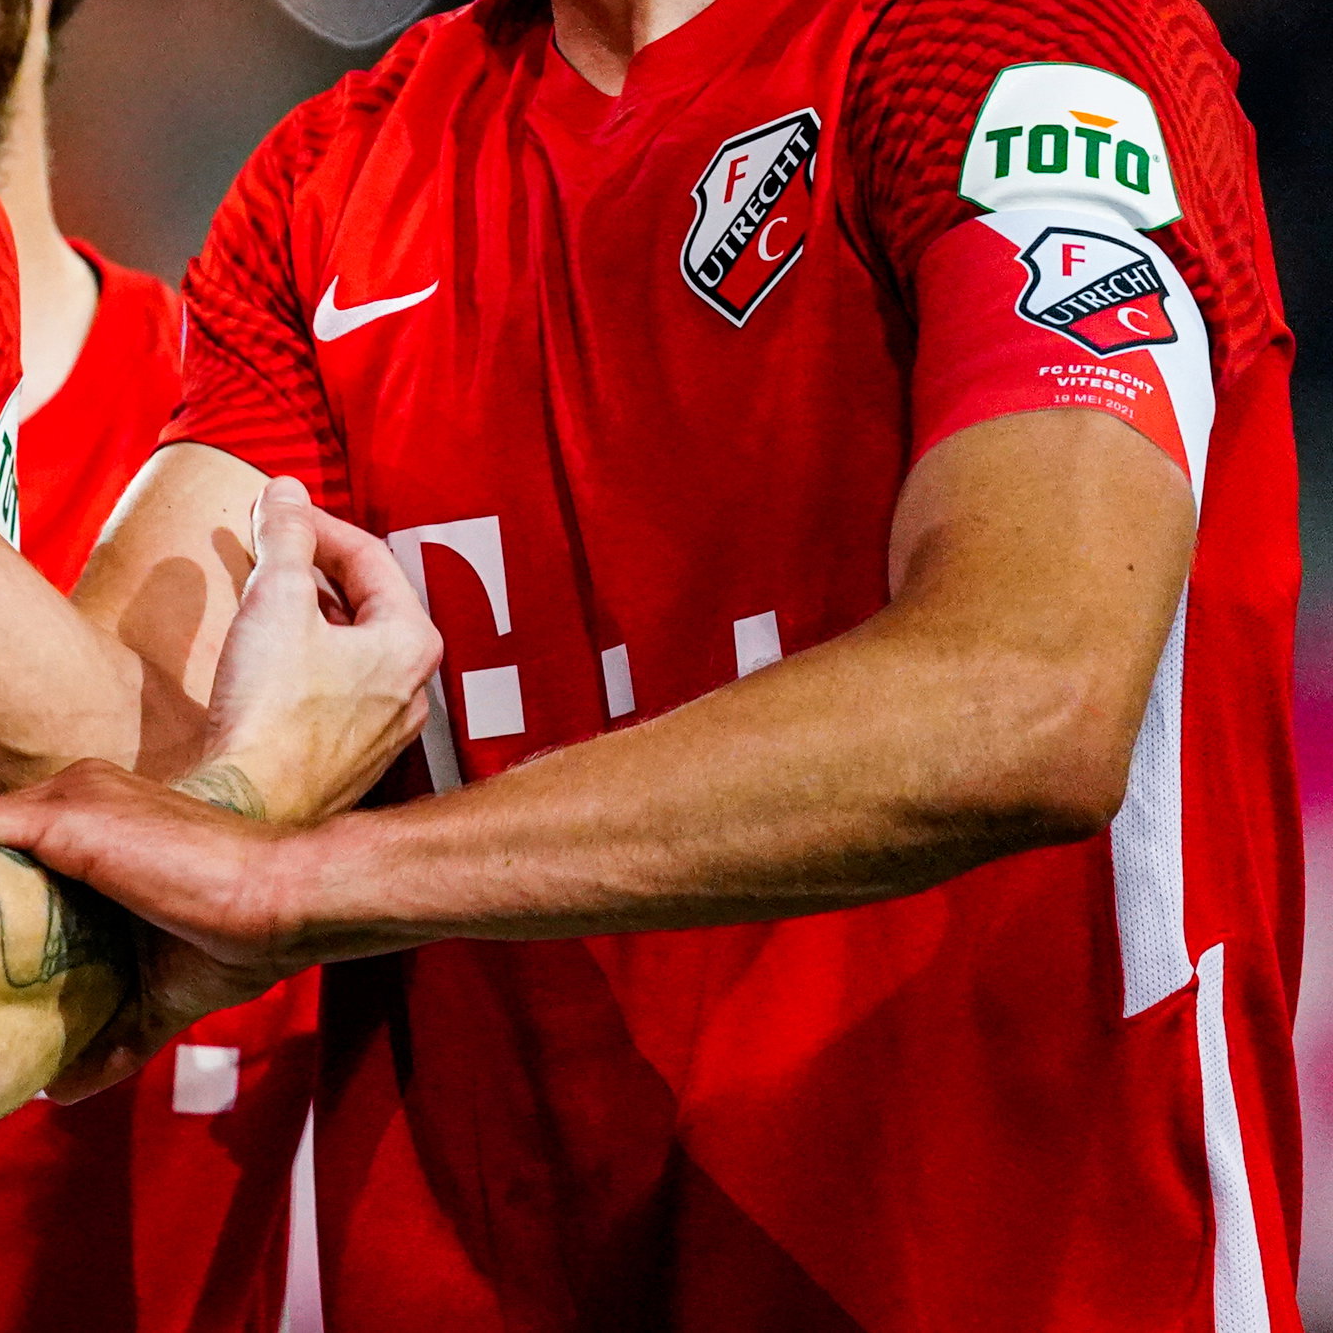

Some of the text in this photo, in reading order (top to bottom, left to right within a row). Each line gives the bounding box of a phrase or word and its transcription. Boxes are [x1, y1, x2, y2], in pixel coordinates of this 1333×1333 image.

[723, 154, 749, 204] F
[985, 124, 1150, 195] TOTO
[697, 125, 812, 288] UTRECHT
[757, 216, 788, 262] C
[1062, 243, 1086, 277] F
[1041, 264, 1159, 326] UTRECHT
[1117, 307, 1151, 336] C
[1038, 364, 1155, 395] FC UTRECHT
[1056, 377, 1138, 401] VITESSE
[1054, 393, 1135, 419] 19 MEI 2021
